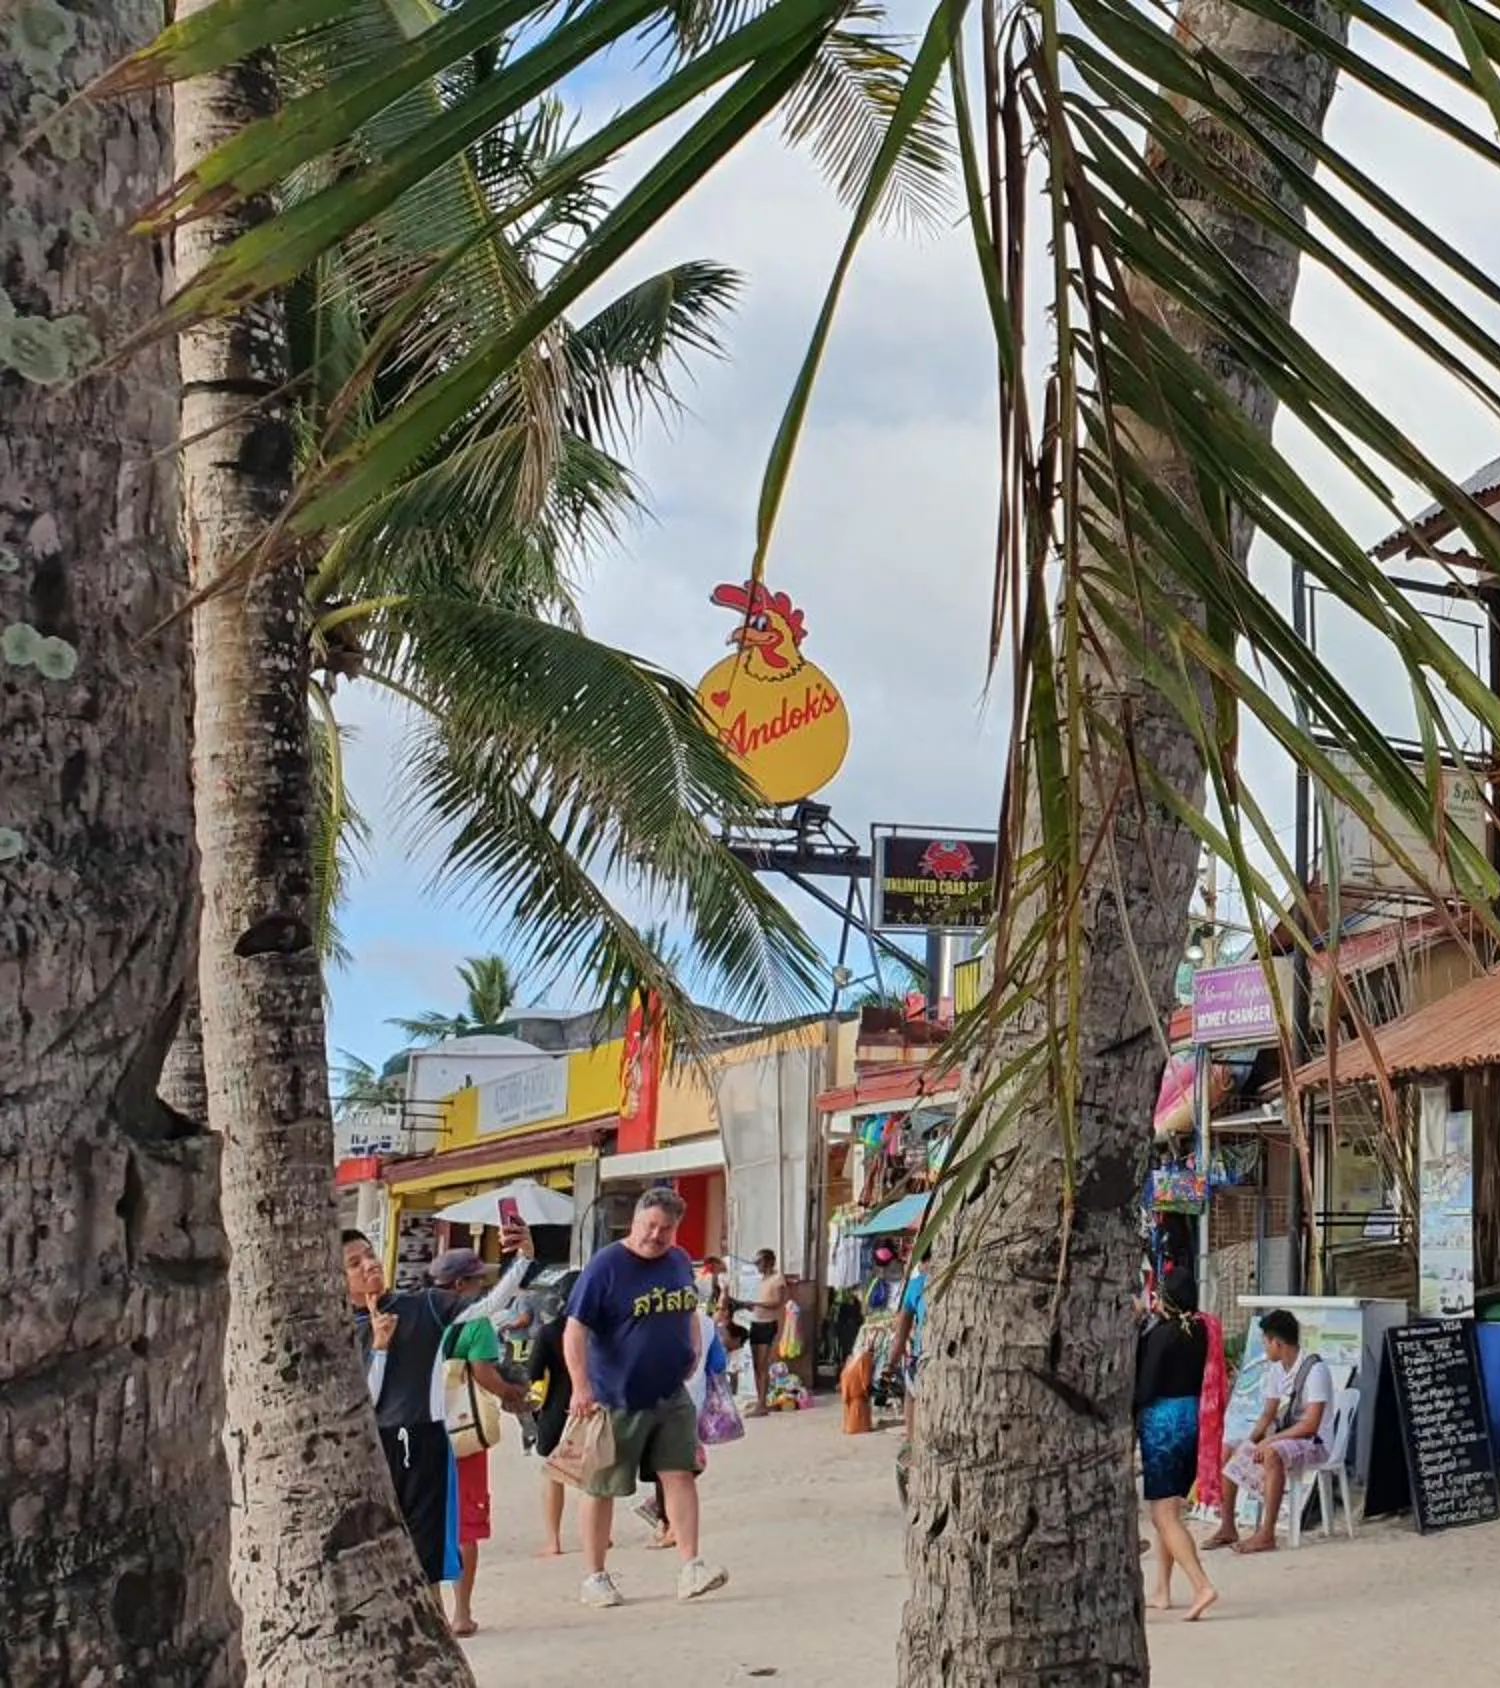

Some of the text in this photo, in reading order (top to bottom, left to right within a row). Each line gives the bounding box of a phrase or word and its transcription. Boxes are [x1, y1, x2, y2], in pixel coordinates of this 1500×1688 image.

[720, 682, 839, 758] Andok's
[1198, 1004, 1270, 1029] MONEY CHANGER
[1441, 1320, 1462, 1332] VISA
